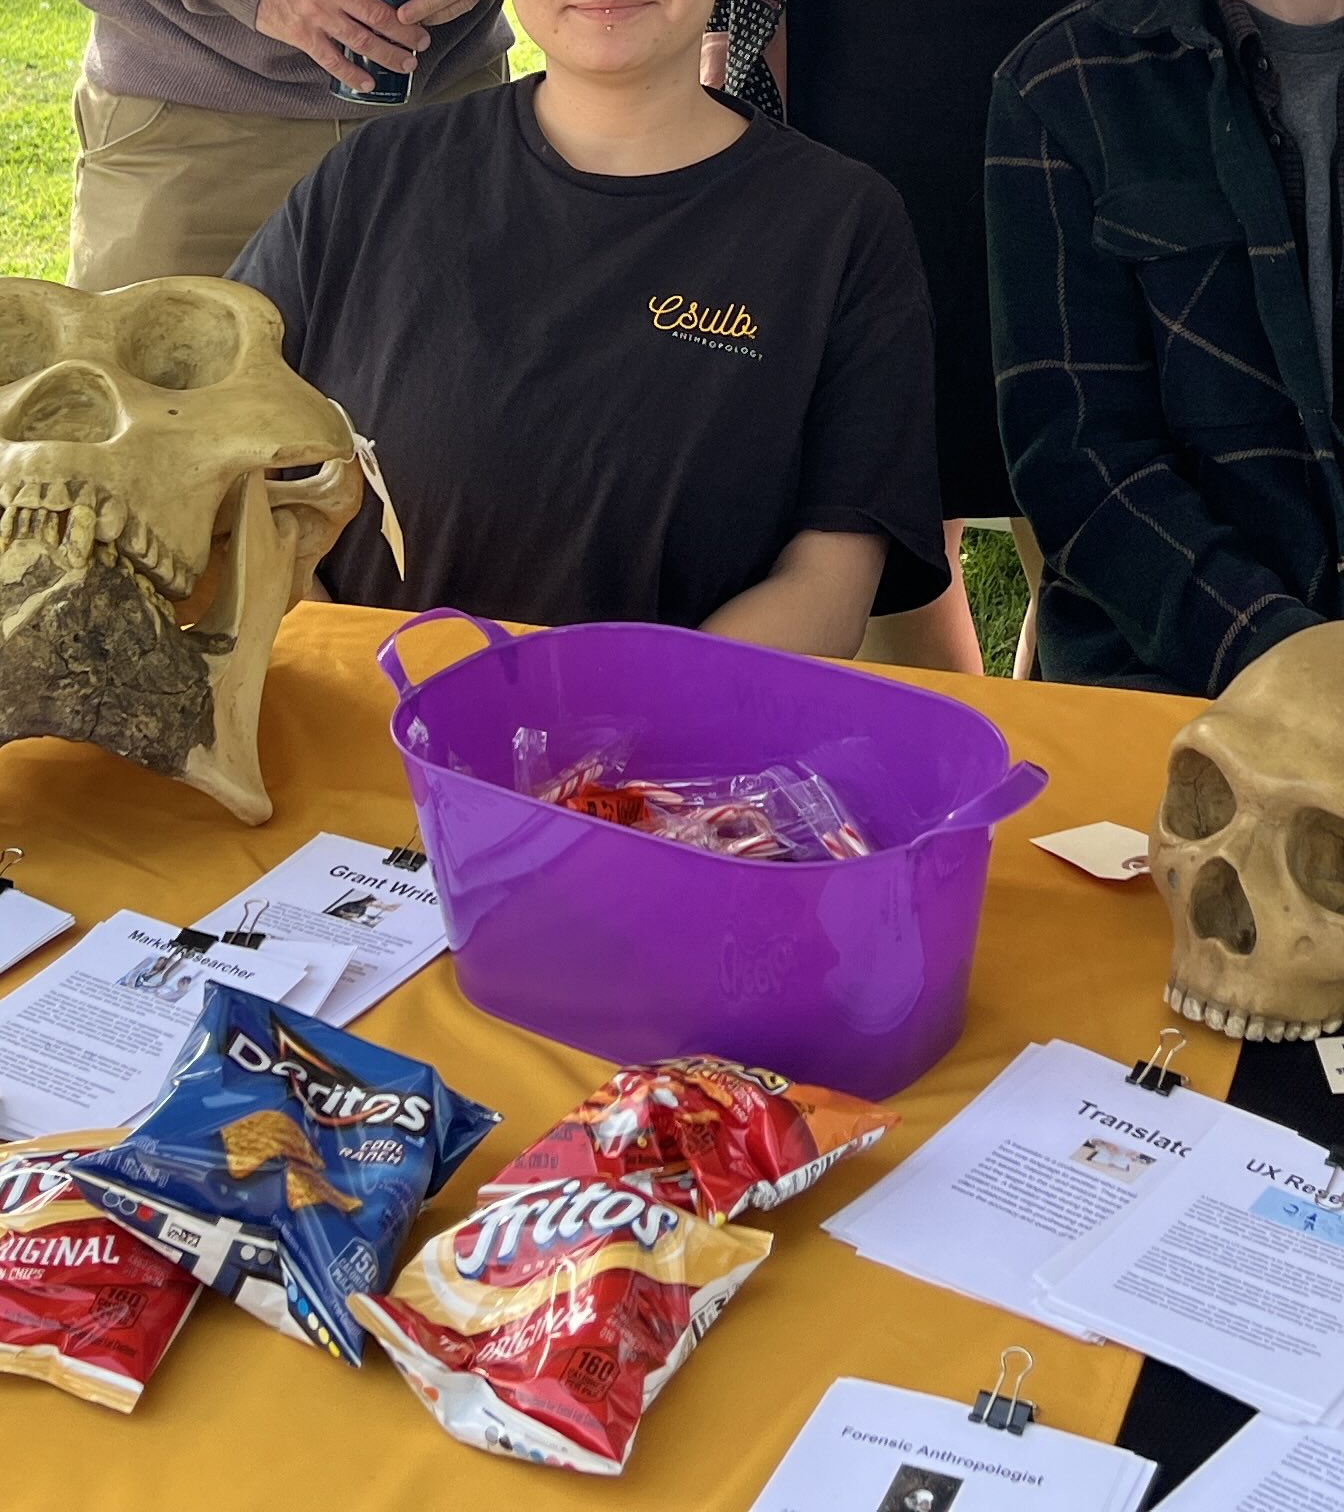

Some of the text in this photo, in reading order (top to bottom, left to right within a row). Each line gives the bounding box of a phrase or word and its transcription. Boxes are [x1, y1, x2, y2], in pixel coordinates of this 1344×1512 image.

[672, 330, 764, 361] ANTHROPOLOGY
[329, 865, 439, 905] Grant Write
[127, 929, 173, 953] Marke
[227, 1032, 432, 1132] Doritos
[338, 1147, 405, 1167] RANCH
[359, 1140, 404, 1156] COOL
[1246, 1158, 1281, 1180] UX
[456, 1178, 679, 1279] Fritos
[348, 1245, 378, 1283] 150
[576, 1349, 615, 1382] 160
[841, 1425, 1043, 1485] Forensic Anthropologist
